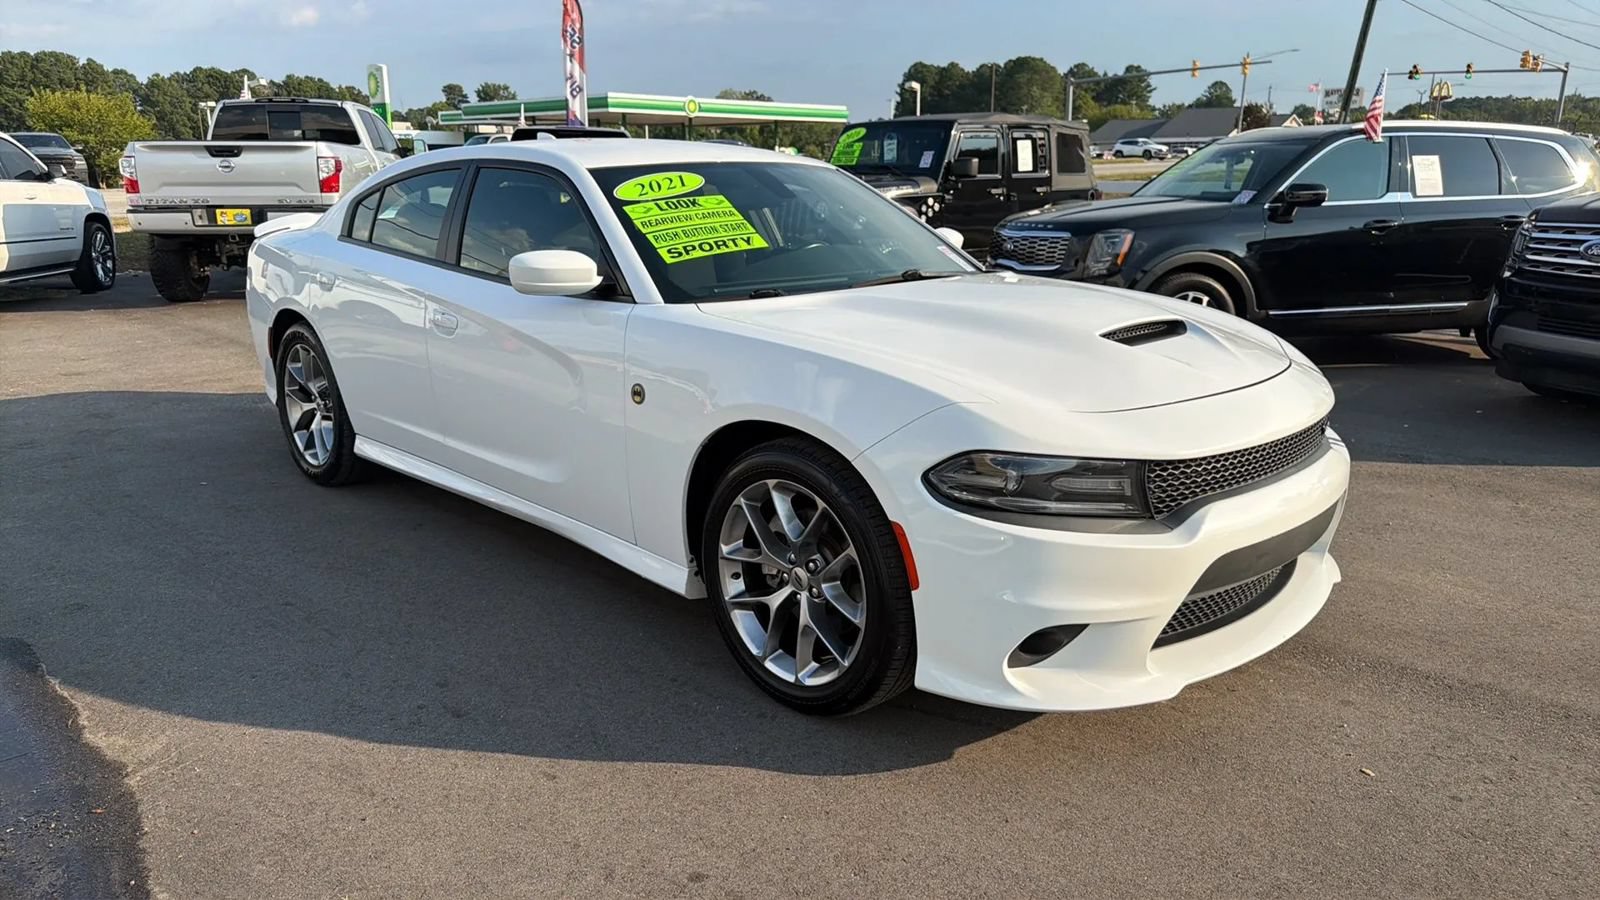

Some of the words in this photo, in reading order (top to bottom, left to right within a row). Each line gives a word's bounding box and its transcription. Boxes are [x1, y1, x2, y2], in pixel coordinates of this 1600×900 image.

[634, 175, 686, 197] 2021
[654, 198, 703, 212] LOOK
[640, 213, 692, 229] REARVIEW
[694, 210, 736, 220] CAMERA
[652, 231, 681, 244] PUSH
[681, 225, 719, 238] BUTTON
[719, 222, 749, 233] START
[667, 237, 752, 259] SPORTY
